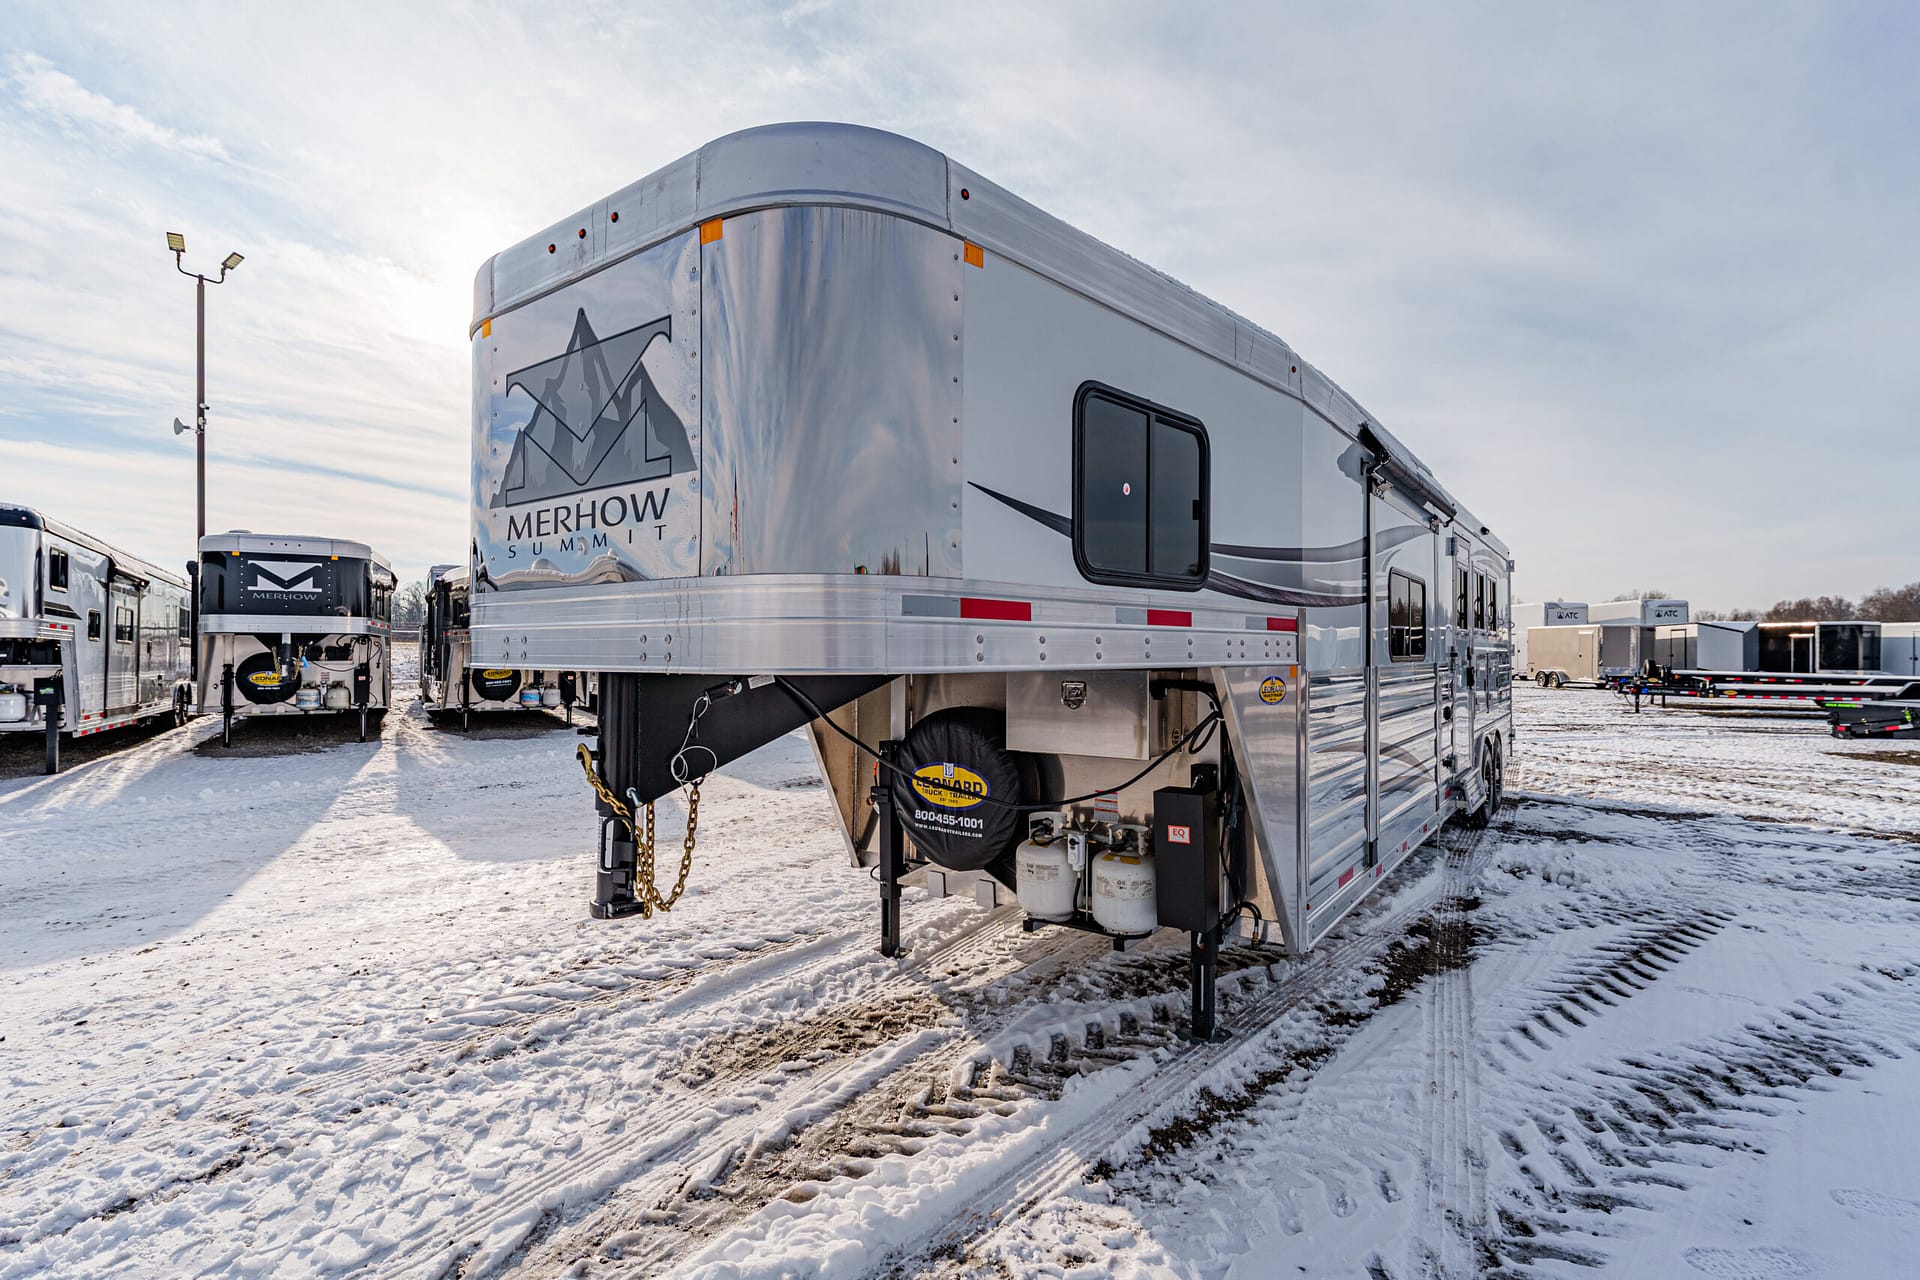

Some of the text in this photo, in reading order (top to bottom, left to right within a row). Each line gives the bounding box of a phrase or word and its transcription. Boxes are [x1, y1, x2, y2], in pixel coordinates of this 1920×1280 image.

[507, 487, 671, 541] MERHOW
[508, 524, 667, 559] SUMMIT
[252, 592, 318, 601] MERHOW
[915, 809, 983, 829] 800-455-1001
[1172, 828, 1185, 839] EQ
